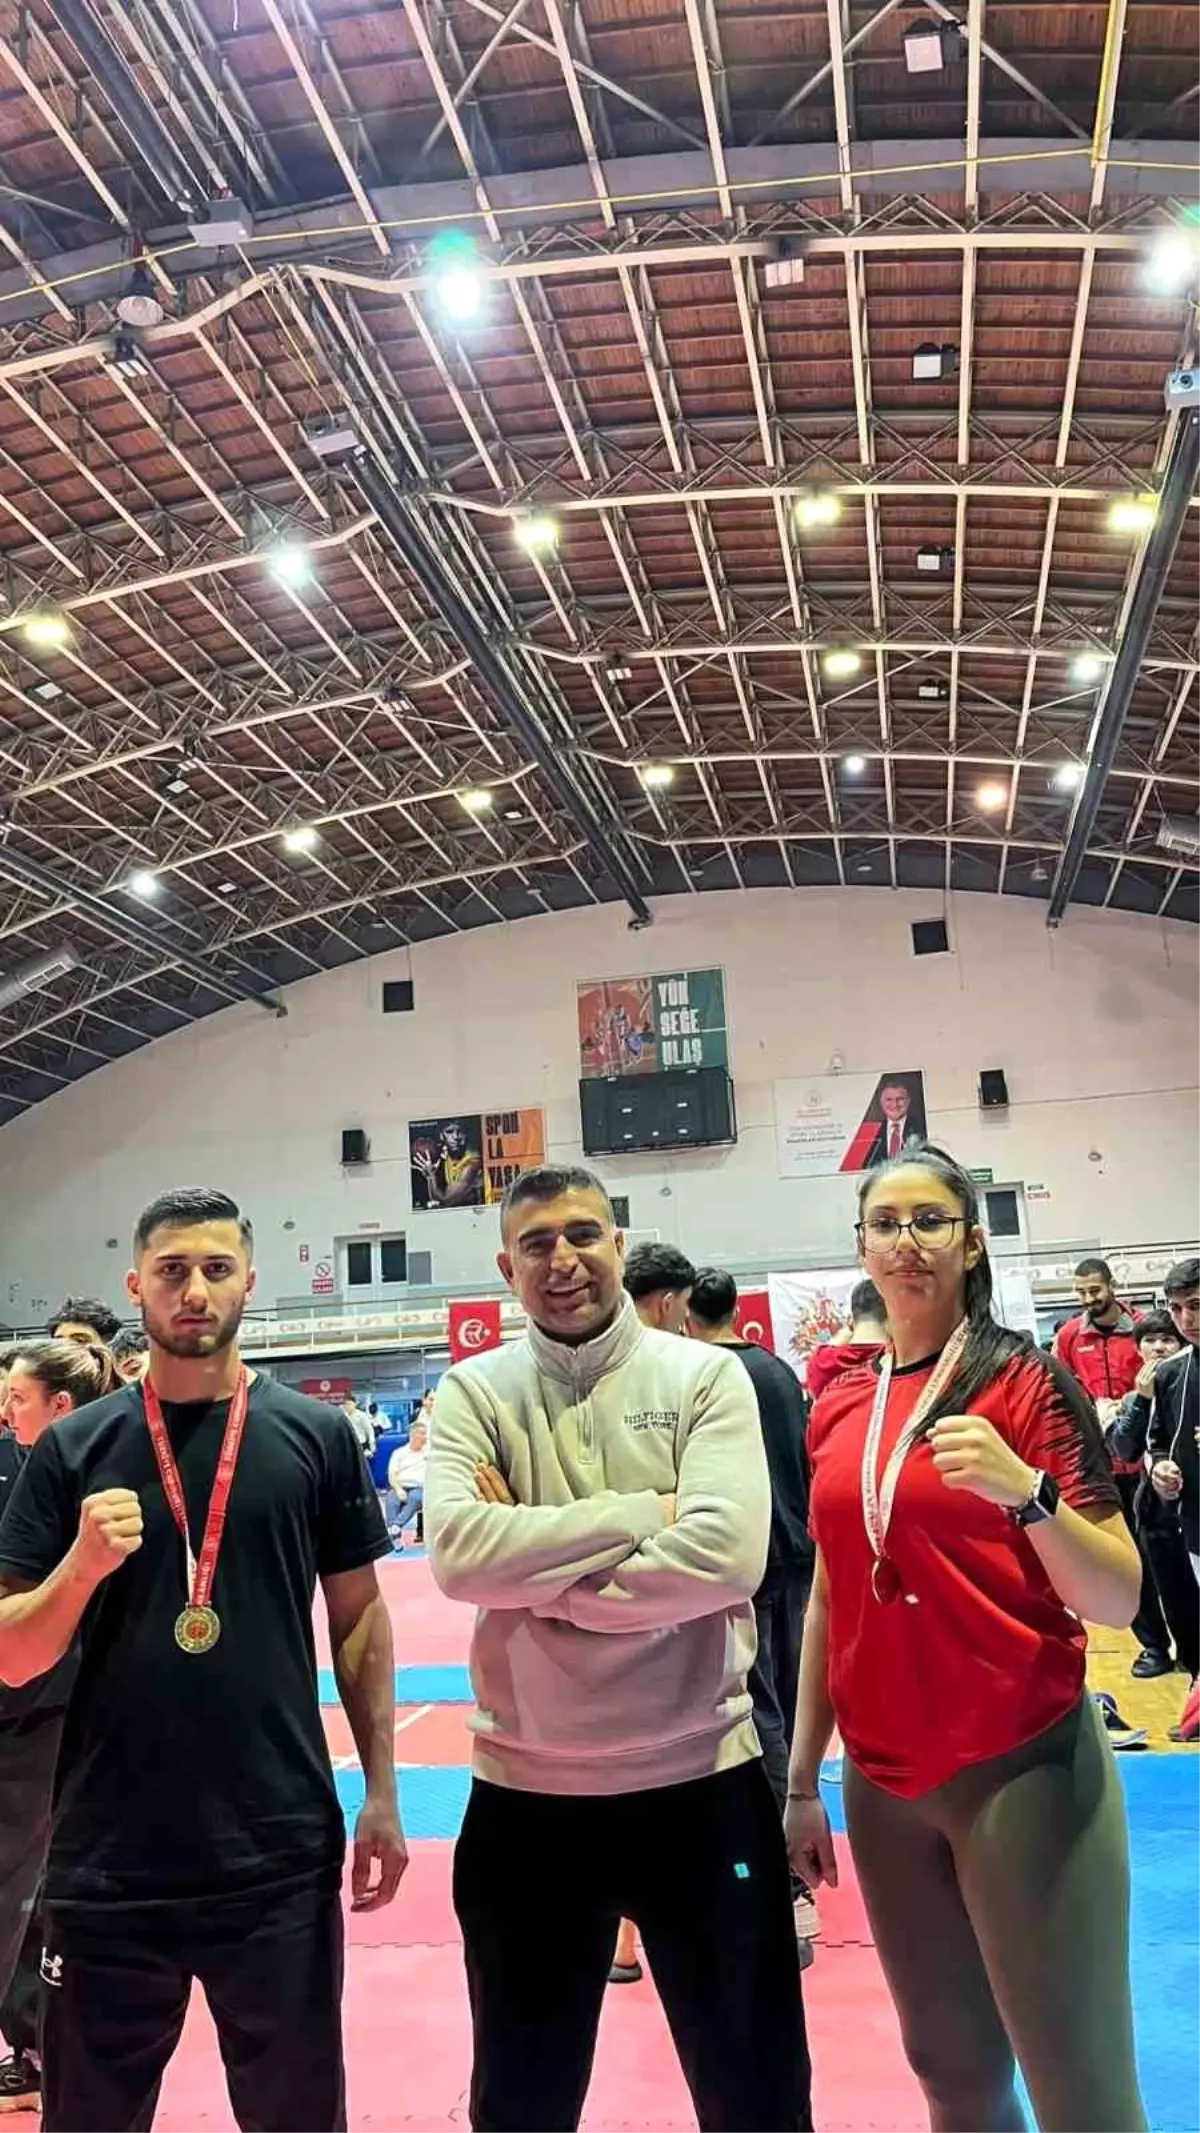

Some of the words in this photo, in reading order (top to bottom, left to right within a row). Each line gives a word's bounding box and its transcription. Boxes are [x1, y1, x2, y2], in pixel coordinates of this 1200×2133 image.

[658, 978, 689, 1007] YÜK
[660, 1007, 700, 1036] SEĞE
[662, 1037, 703, 1066] ULAŞ
[485, 1110, 520, 1136] SPOR
[487, 1137, 504, 1158] LA
